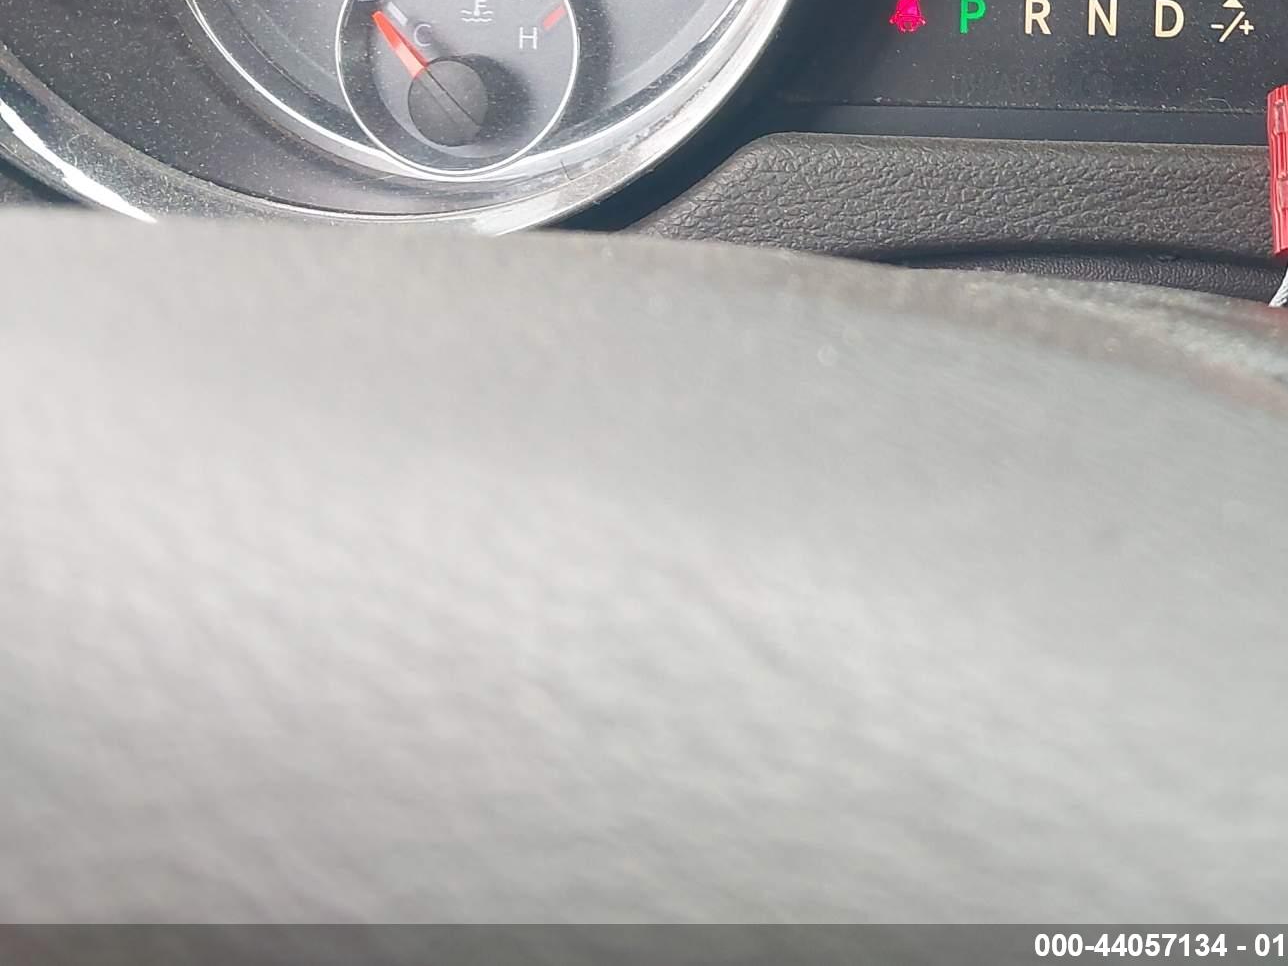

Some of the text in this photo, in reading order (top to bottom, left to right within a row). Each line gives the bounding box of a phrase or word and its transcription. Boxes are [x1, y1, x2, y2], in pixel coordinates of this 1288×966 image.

[1154, 0, 1186, 38] D
[413, 23, 433, 47] C
[519, 27, 537, 50] H
